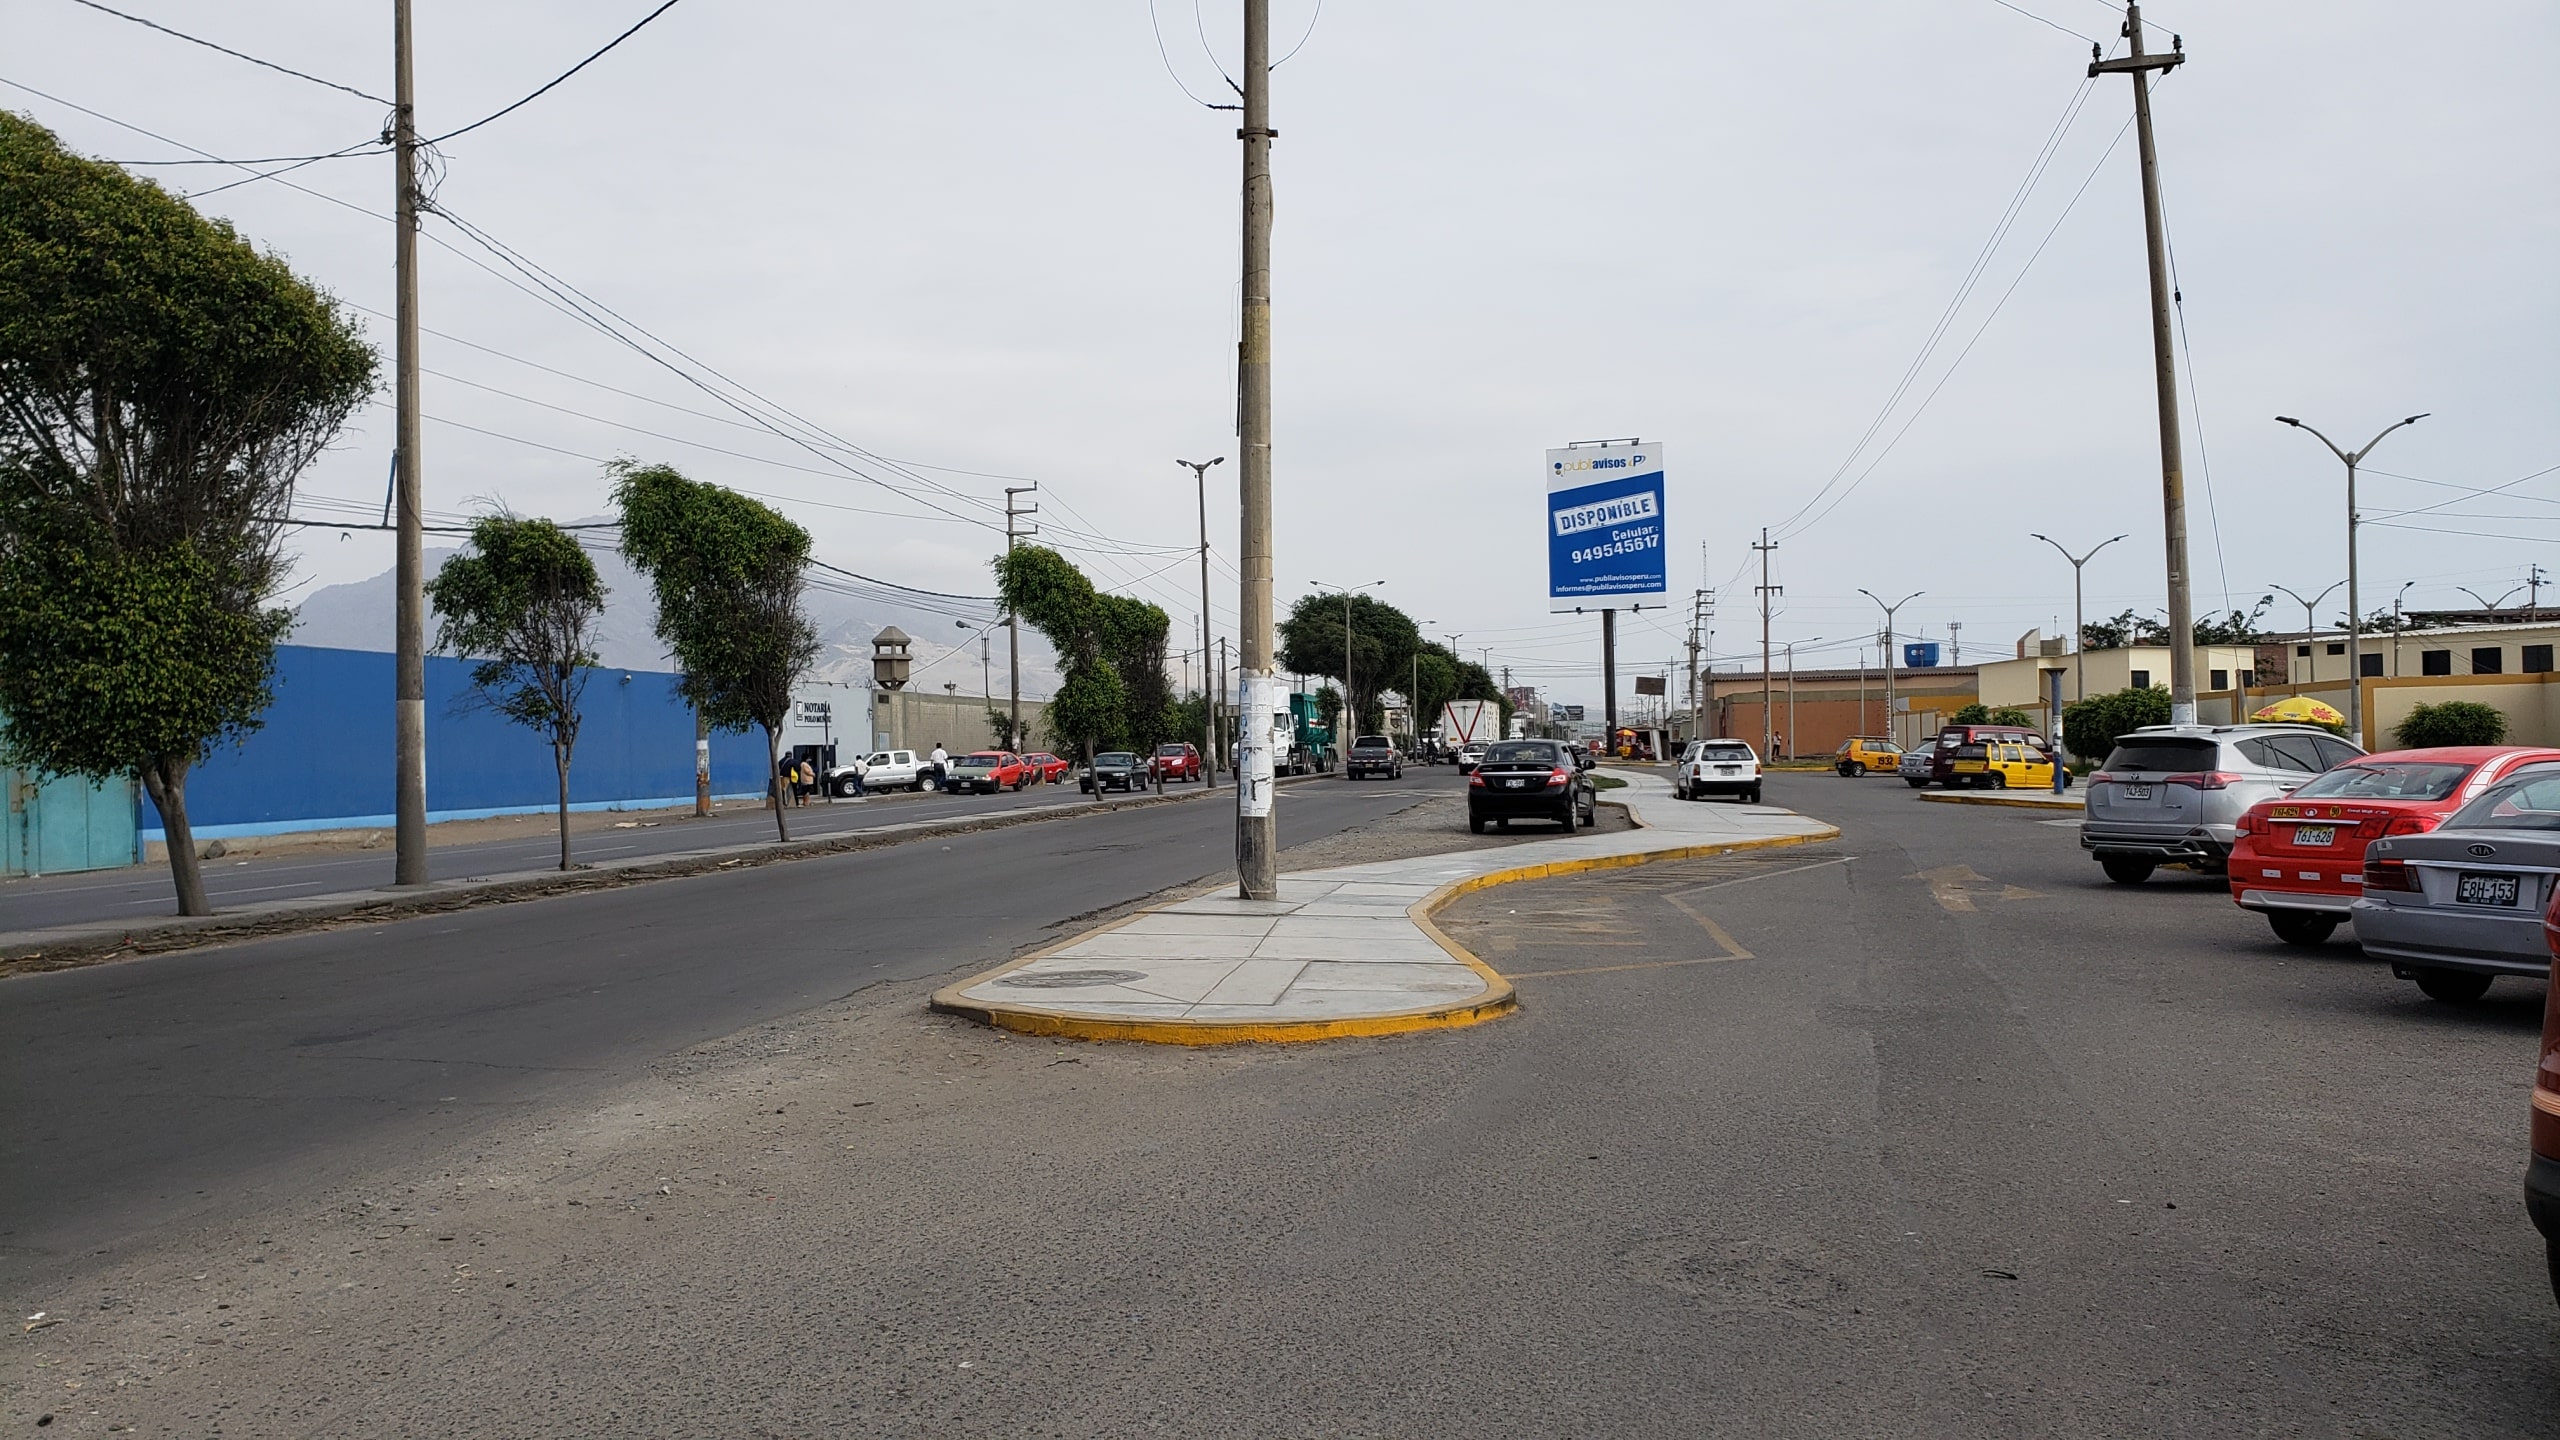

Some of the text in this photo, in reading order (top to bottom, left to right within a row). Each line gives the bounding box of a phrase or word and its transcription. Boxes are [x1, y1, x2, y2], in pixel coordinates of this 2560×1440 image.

[1560, 498, 1651, 530] DISPONIBLE
[1612, 525, 1659, 541] Celular:
[1571, 534, 1659, 563] 949545617
[1579, 573, 1661, 584] www.publiavisosperu.com
[1556, 581, 1662, 593] informes@publiavisosperu.com
[804, 702, 831, 713] NOTARA
[2461, 881, 2514, 900] F8H-153
